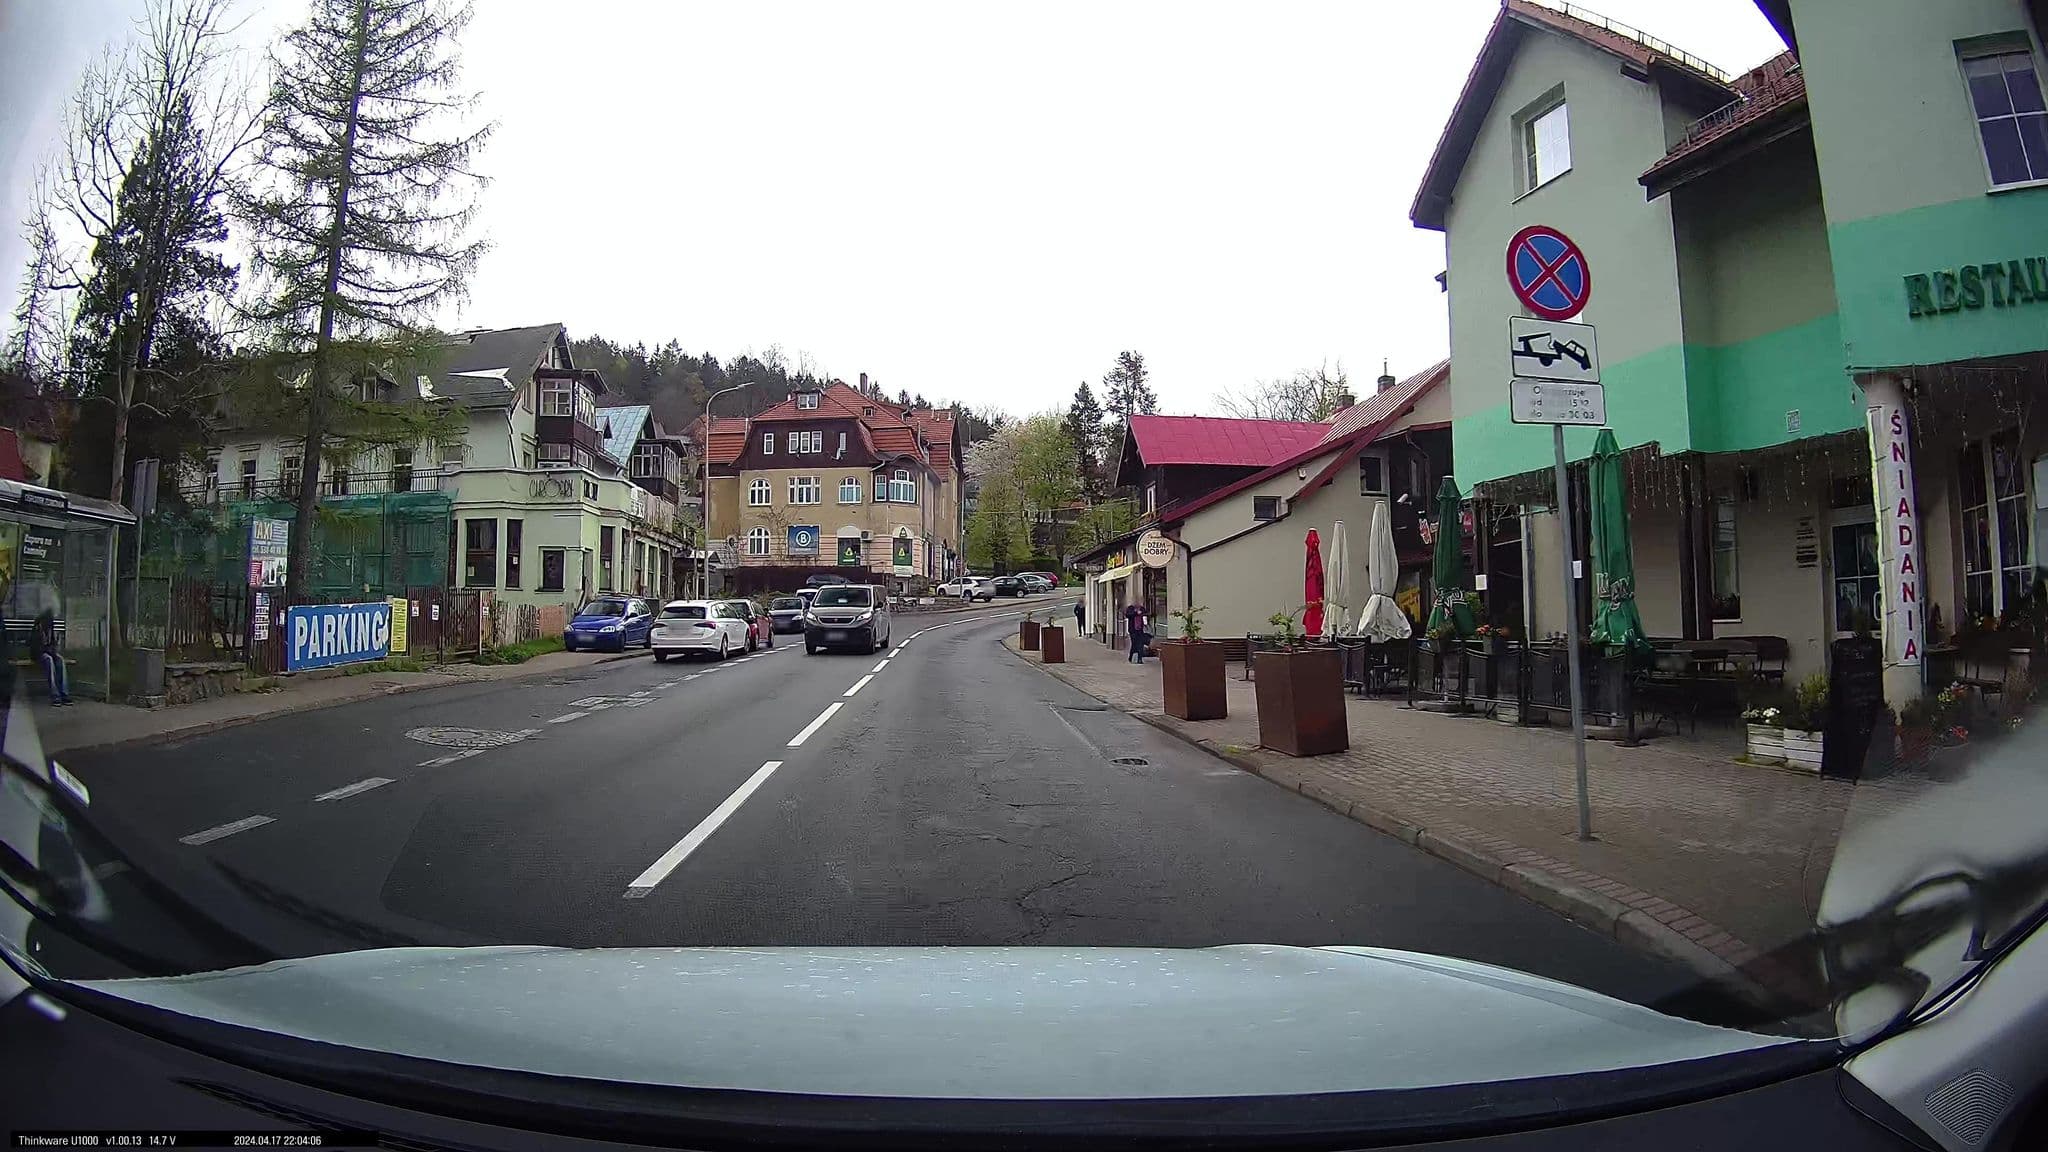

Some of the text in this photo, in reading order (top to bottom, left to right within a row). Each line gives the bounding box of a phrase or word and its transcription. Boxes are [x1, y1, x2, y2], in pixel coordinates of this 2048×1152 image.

[255, 521, 272, 540] TAXI
[1891, 409, 1918, 660] ŚNIADANIA
[294, 610, 385, 660] PARKING
